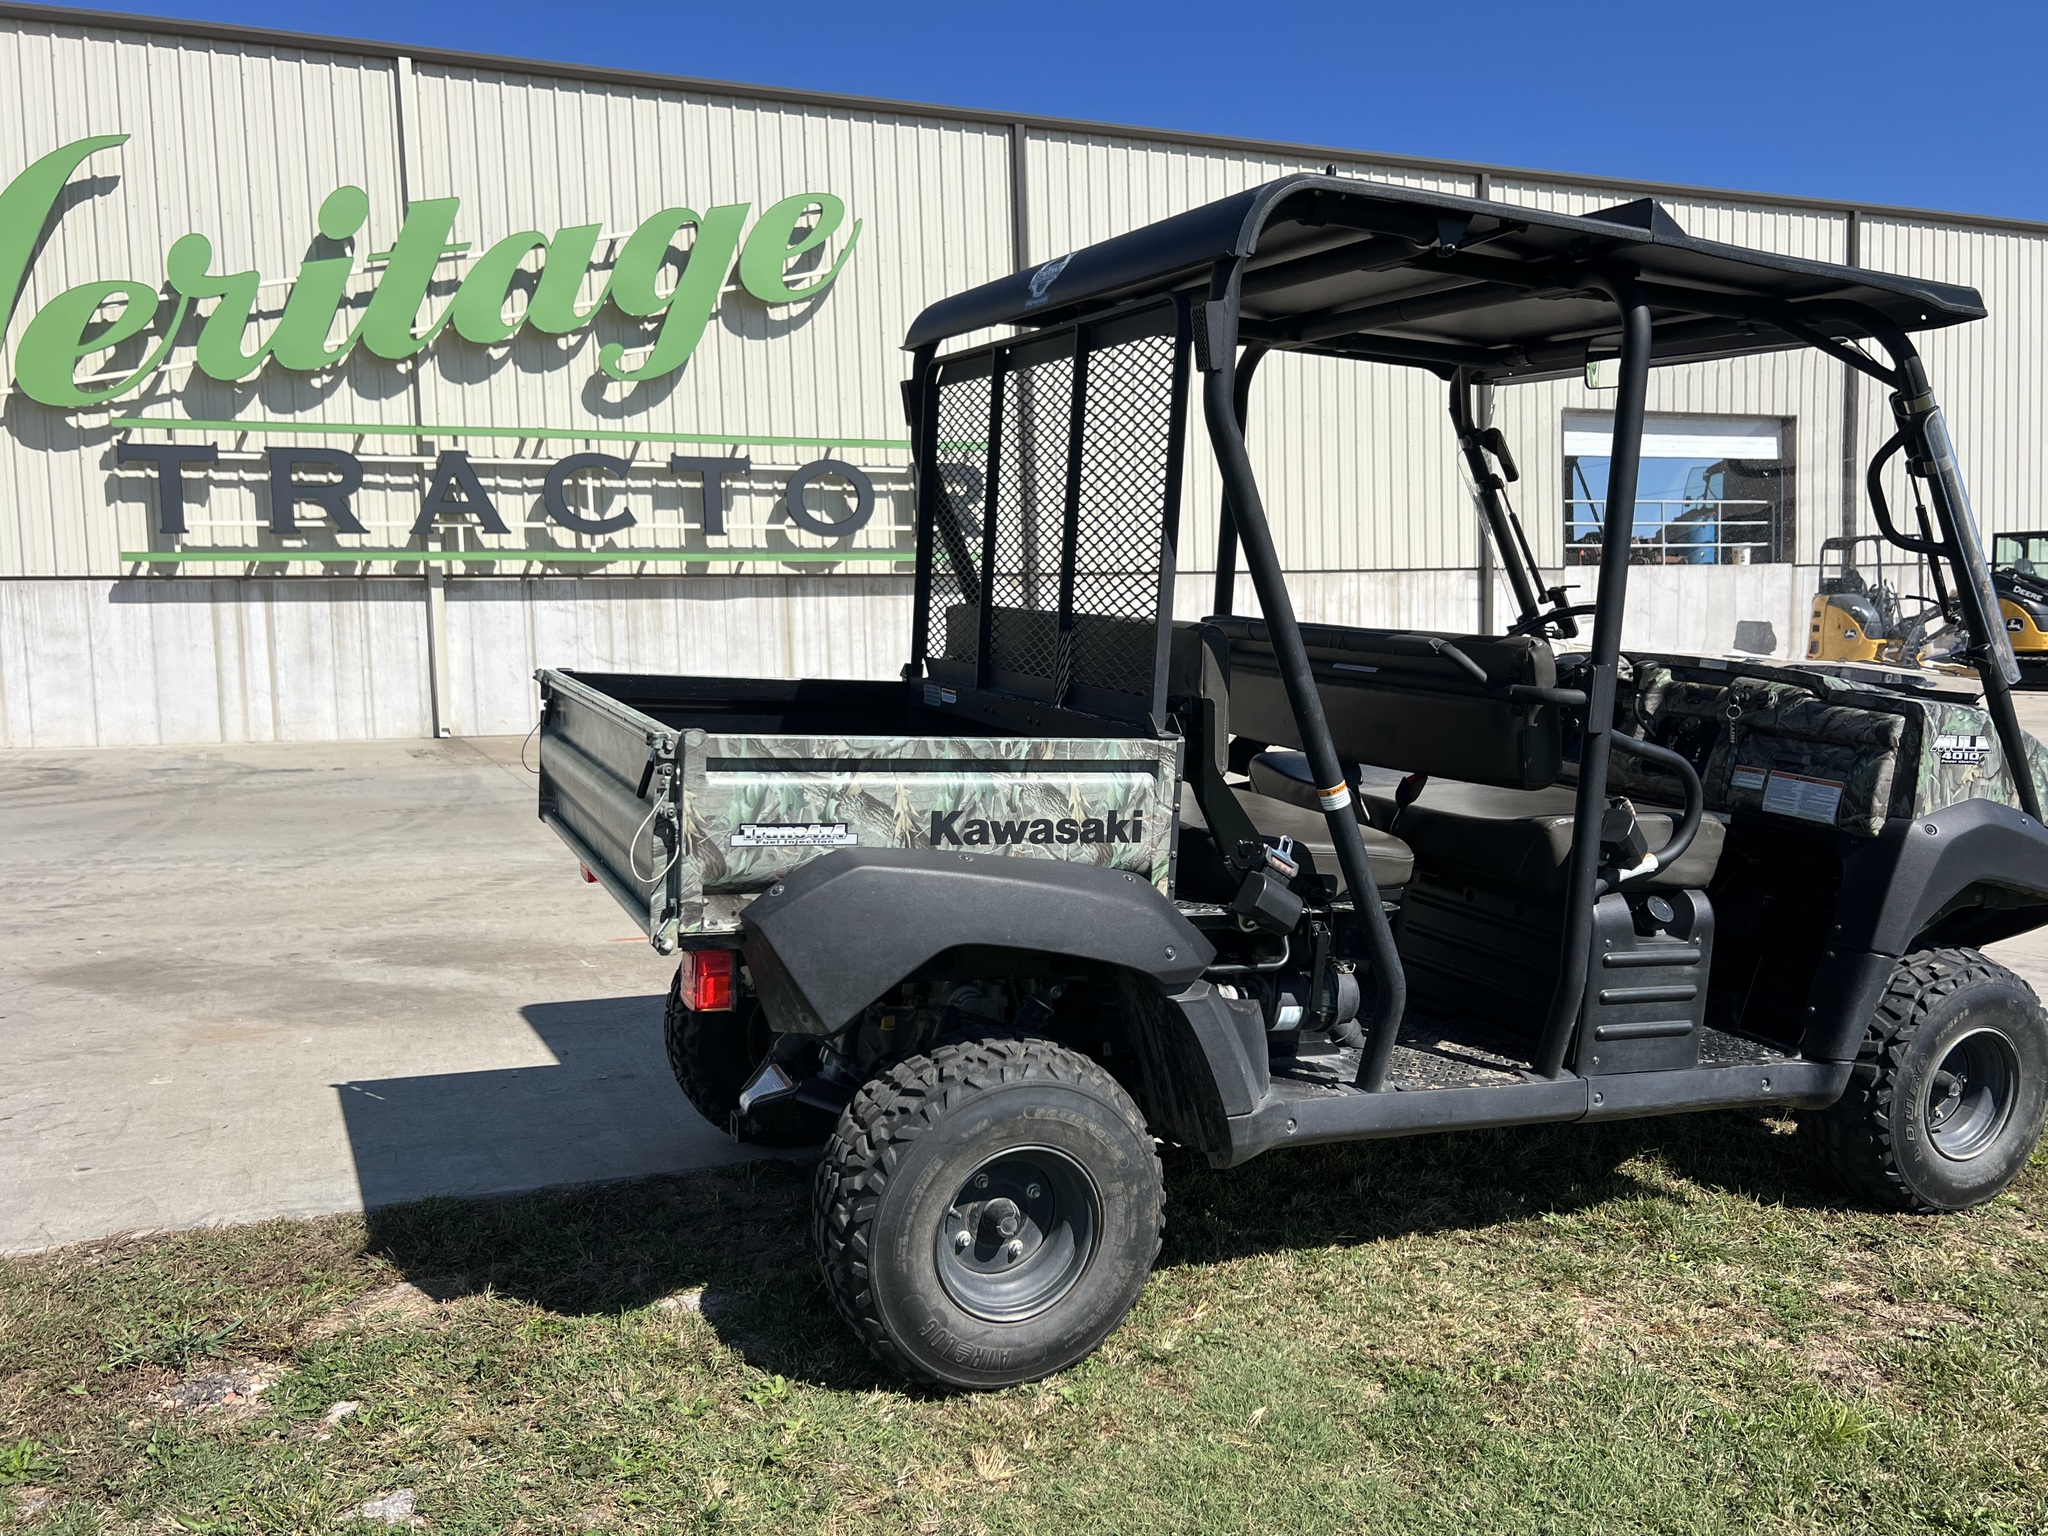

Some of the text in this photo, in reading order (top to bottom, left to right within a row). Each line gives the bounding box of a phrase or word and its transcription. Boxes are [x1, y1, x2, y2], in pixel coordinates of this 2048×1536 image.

[2013, 585, 2044, 602] DEERE
[1930, 734, 1992, 752] MULE
[1942, 752, 1980, 760] 4010
[741, 824, 847, 841] Trans4x4
[930, 810, 1143, 846] Kawasaki
